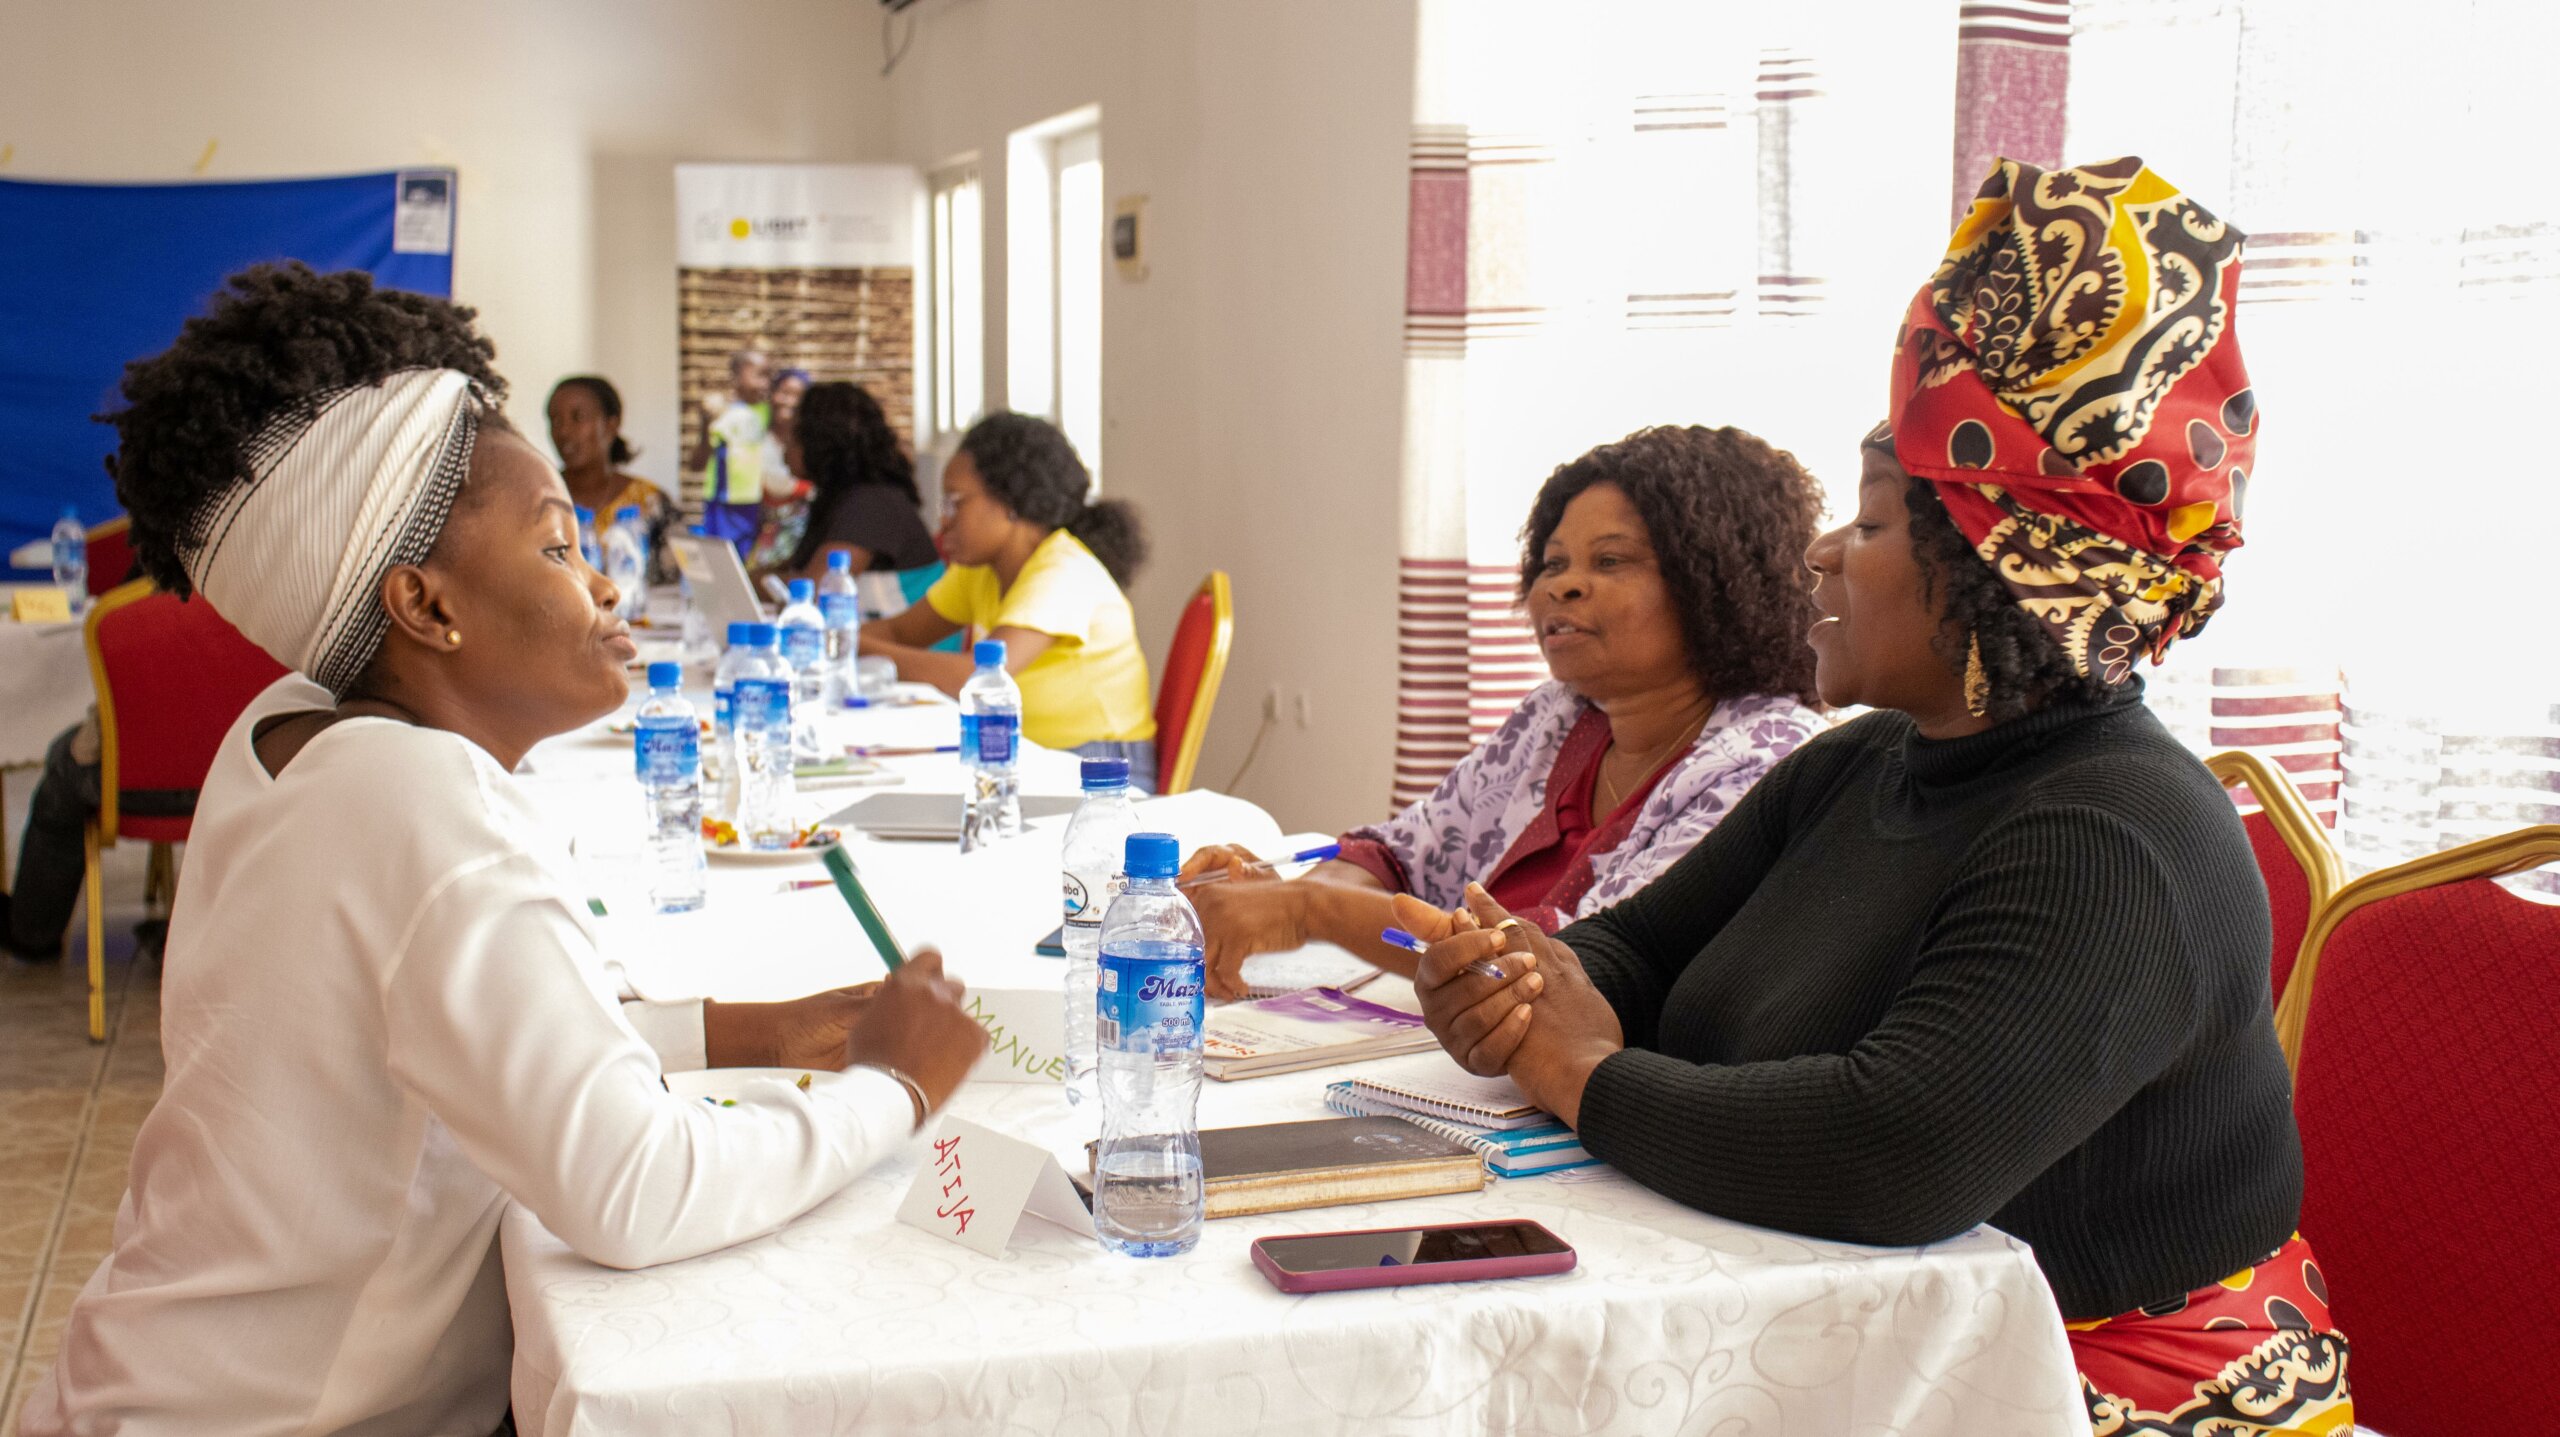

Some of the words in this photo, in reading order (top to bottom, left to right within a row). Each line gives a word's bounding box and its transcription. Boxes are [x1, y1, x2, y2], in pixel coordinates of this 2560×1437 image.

[1138, 974, 1201, 1003] Mazi
[1162, 1017, 1180, 1028] 500
[933, 1135, 975, 1236] ATIJA
